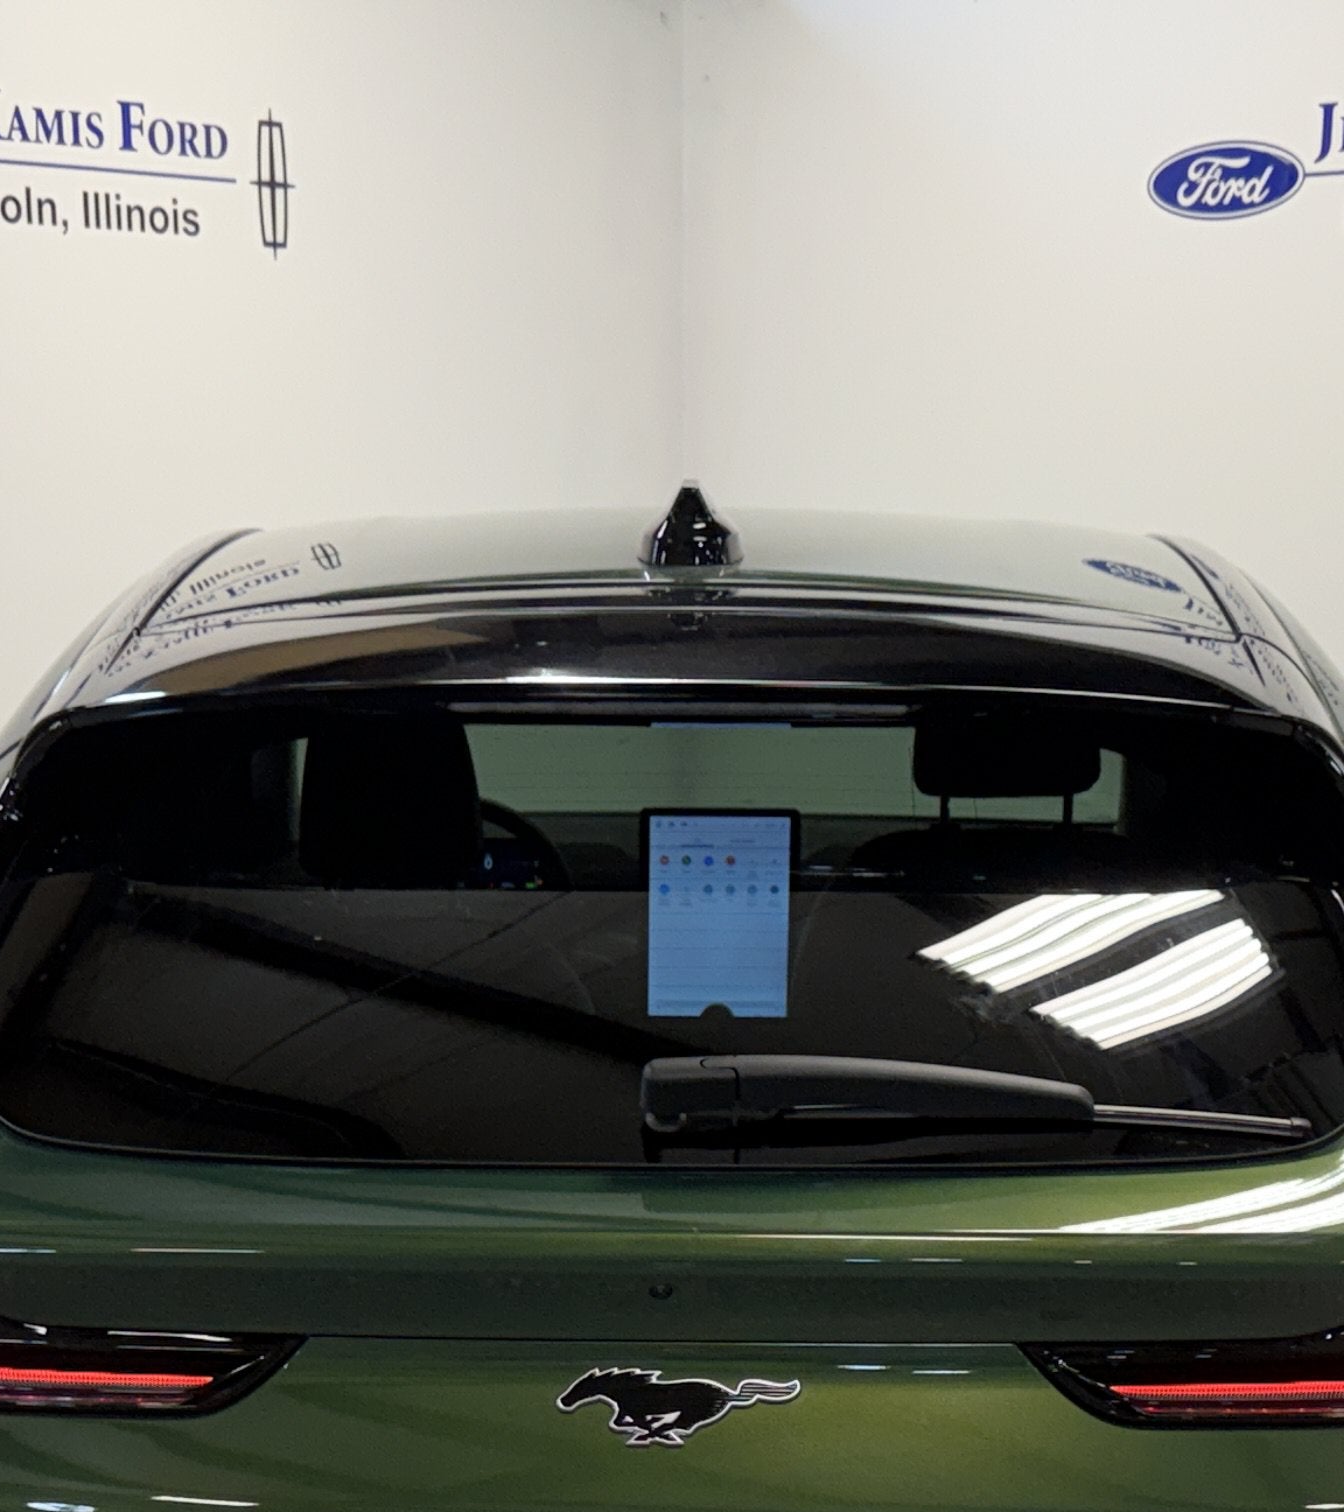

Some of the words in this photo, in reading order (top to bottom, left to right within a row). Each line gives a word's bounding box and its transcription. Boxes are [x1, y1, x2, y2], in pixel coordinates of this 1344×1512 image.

[117, 100, 228, 159] FORD
[1175, 154, 1272, 208] Ford
[82, 191, 200, 236] Illinois
